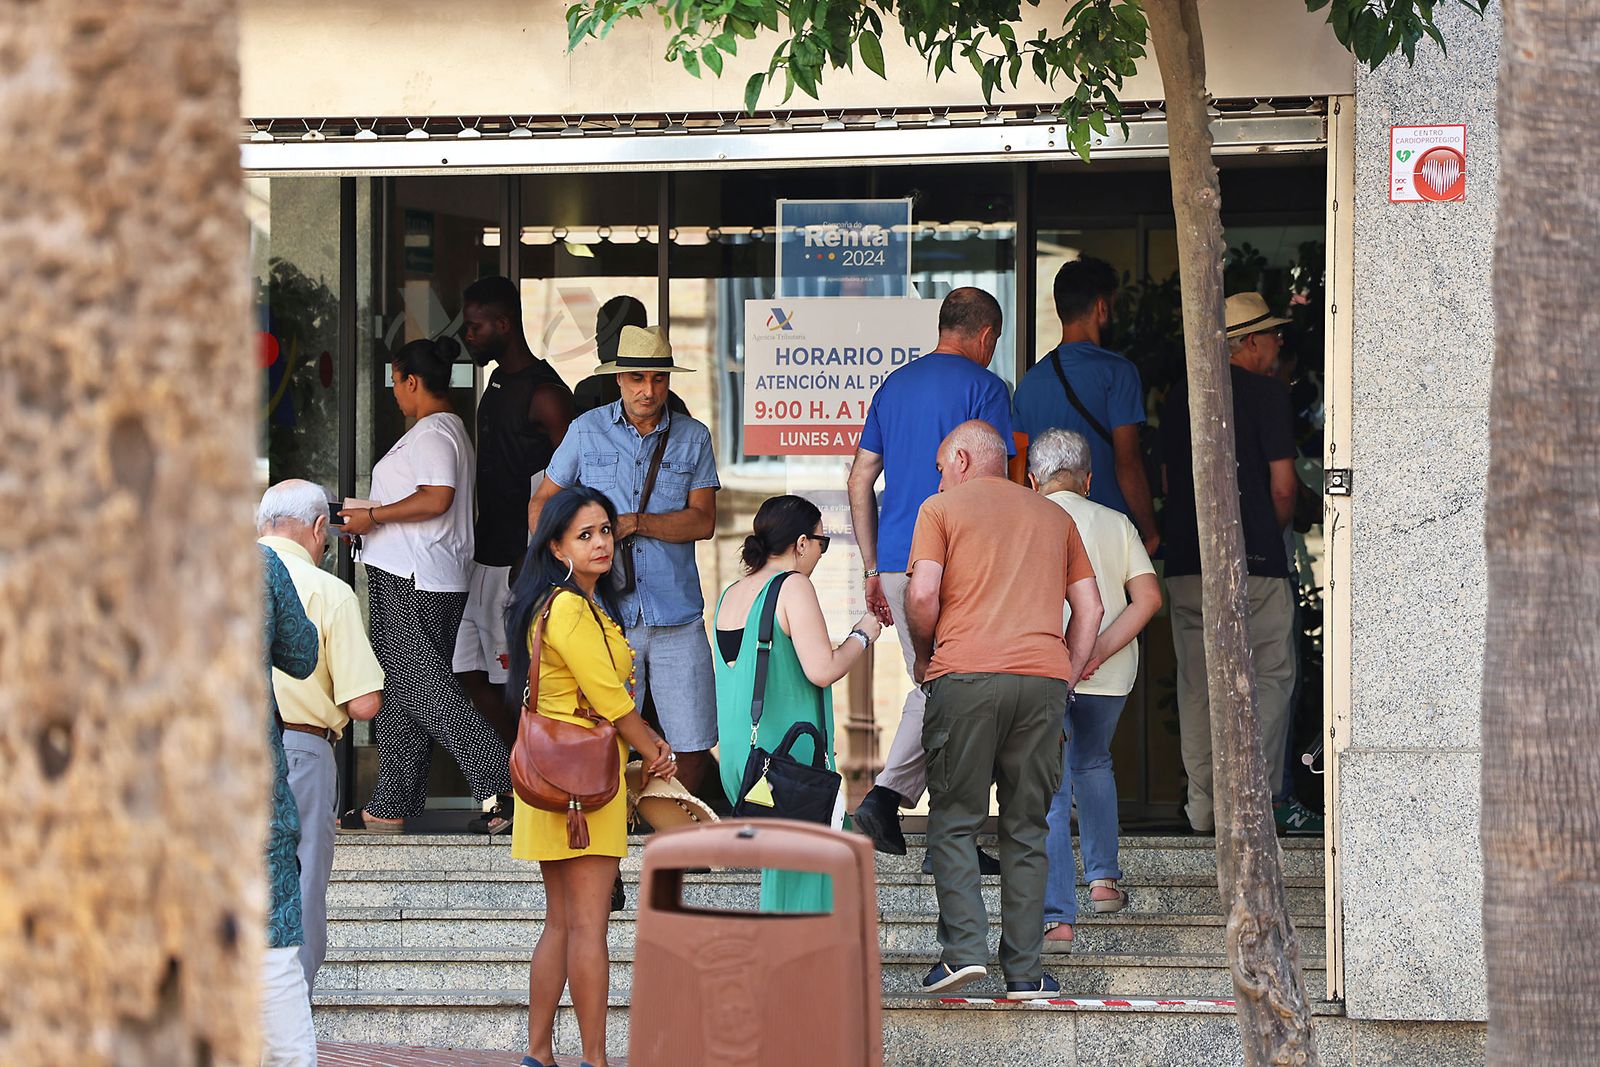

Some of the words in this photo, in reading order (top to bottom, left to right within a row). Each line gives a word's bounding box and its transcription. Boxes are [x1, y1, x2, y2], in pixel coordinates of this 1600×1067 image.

[1395, 136, 1460, 144] CARDIOPROTEGIDO
[1413, 129, 1444, 137] CENTRO
[804, 225, 889, 247] Renta
[842, 250, 885, 266] 2024
[752, 334, 775, 342] Agencia
[776, 333, 806, 341] Tributaria
[775, 347, 884, 366] HORARIO
[891, 347, 921, 365] DE
[755, 371, 842, 389] ATENCIÓN
[844, 375, 865, 389] AL
[754, 400, 802, 419] 9:00
[809, 400, 830, 419] H.
[836, 400, 852, 419] A
[858, 400, 870, 419] 1
[780, 431, 829, 446] LUNES
[833, 432, 844, 446] A
